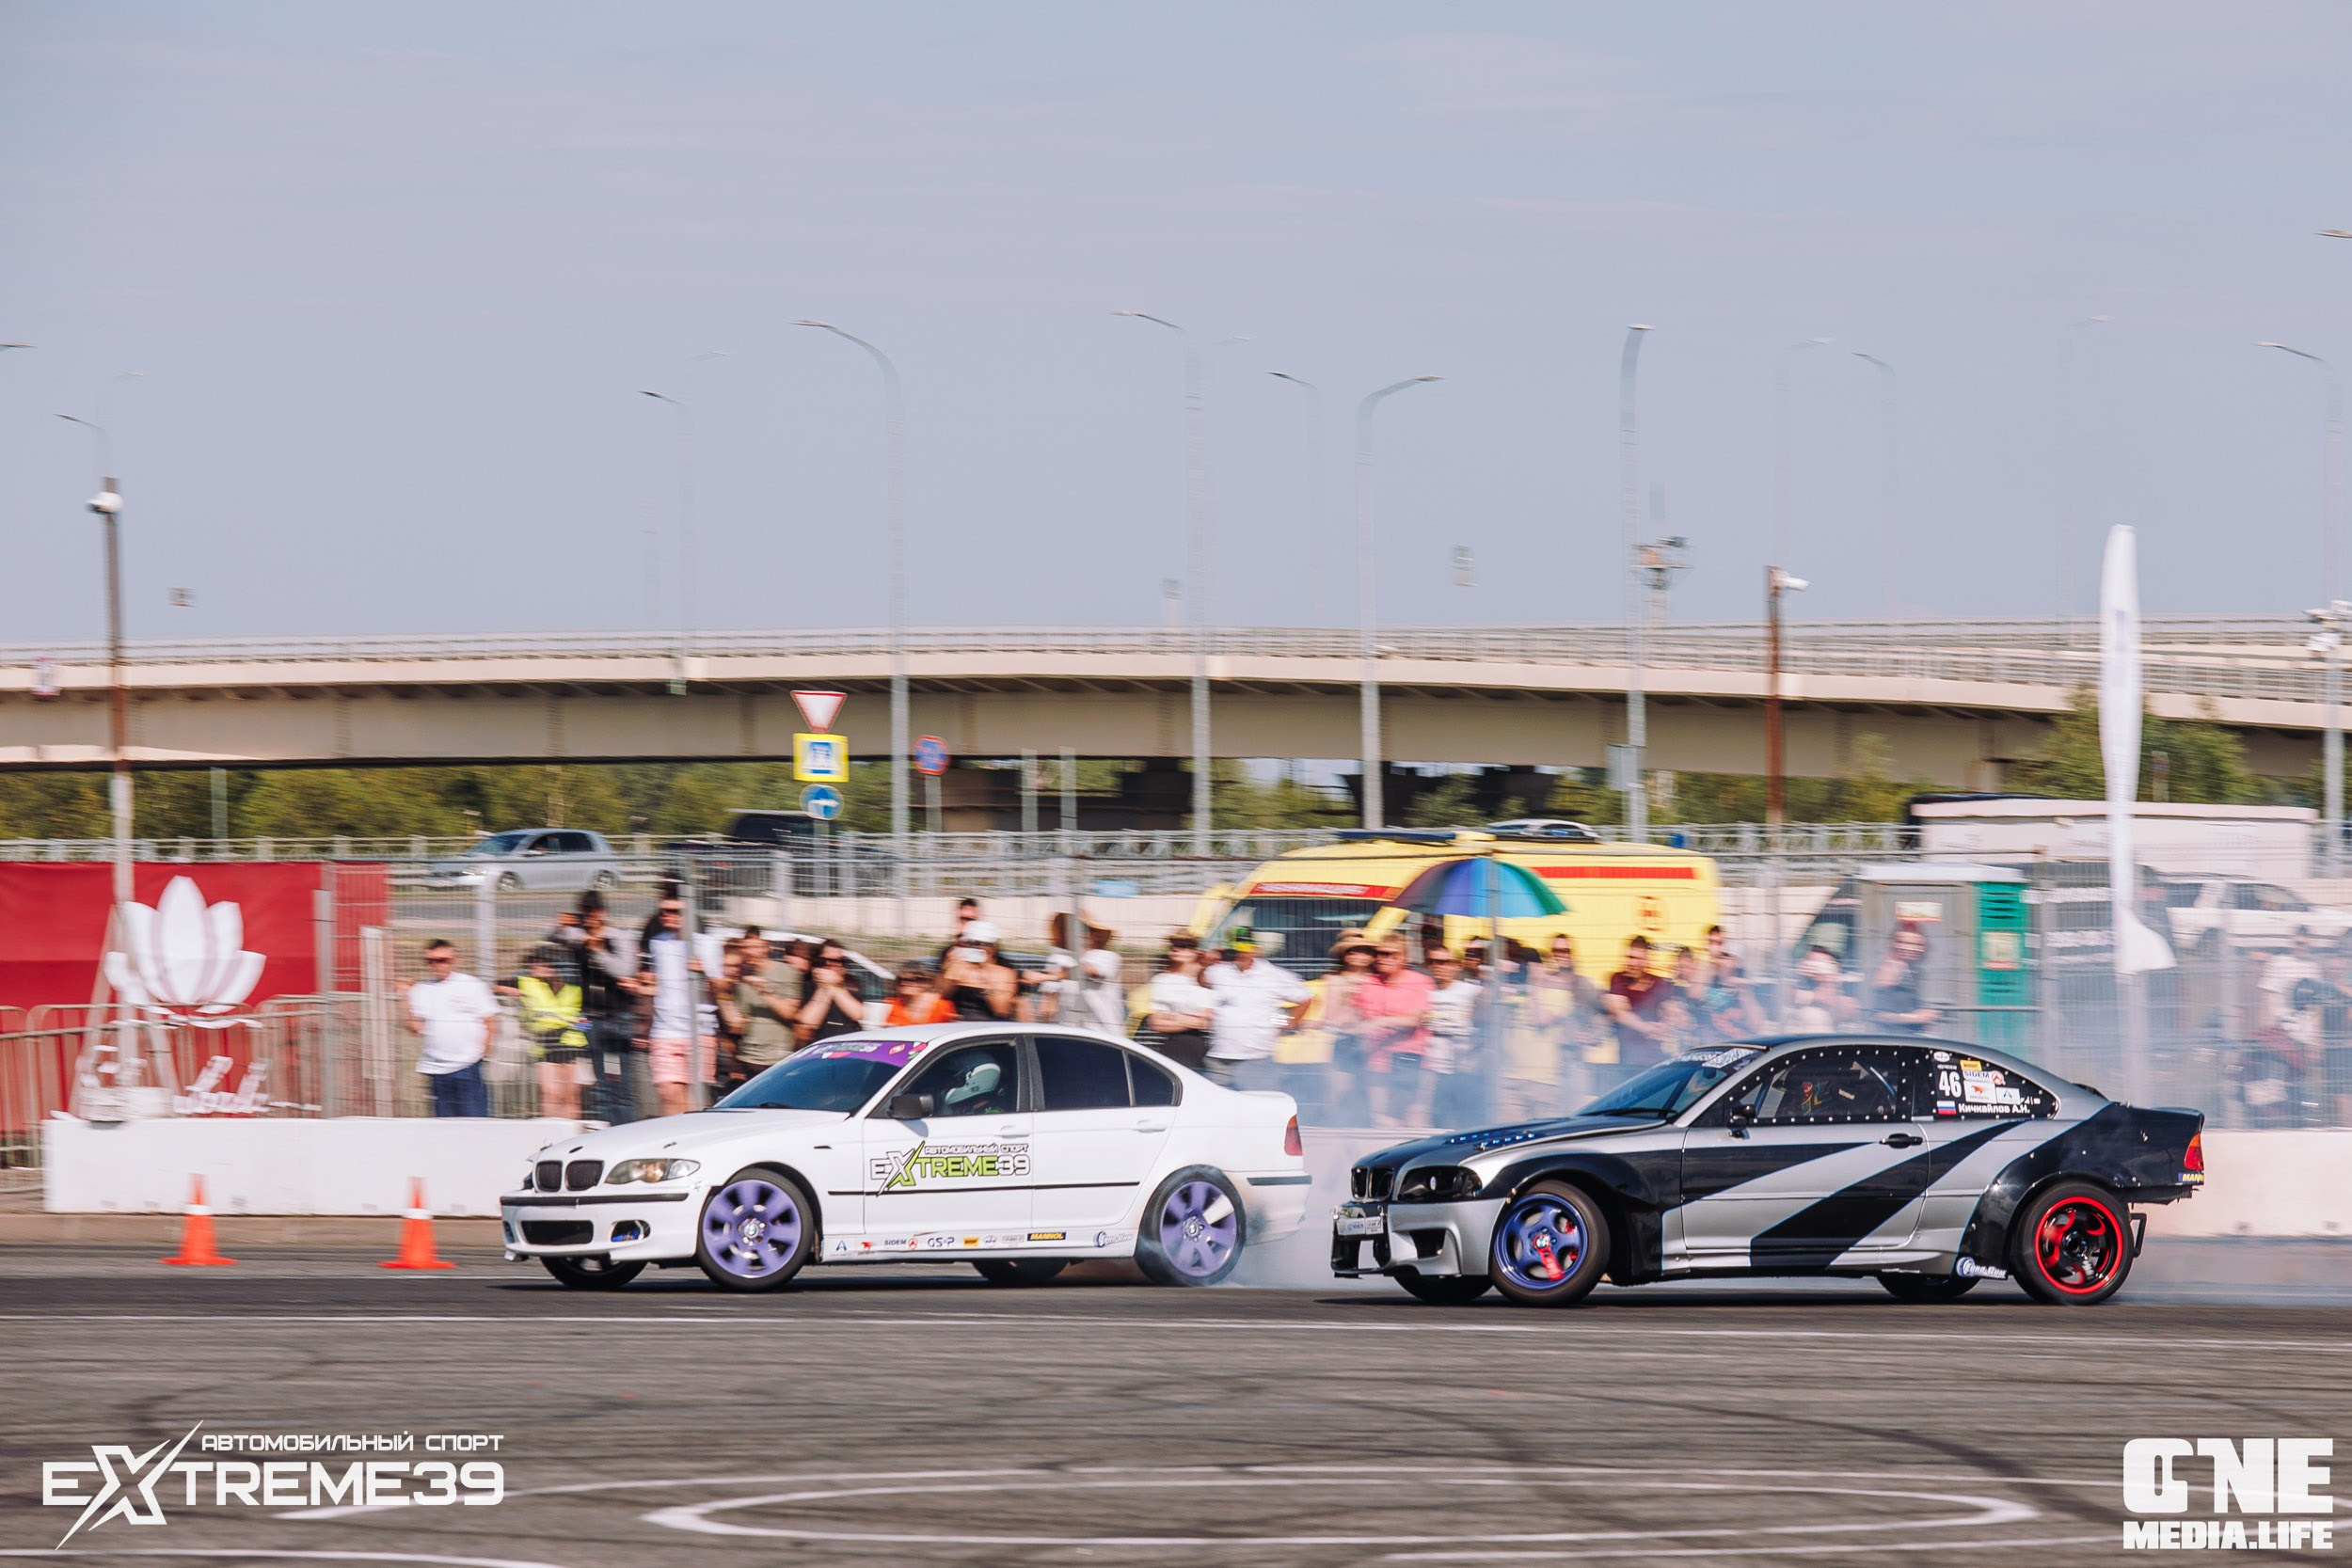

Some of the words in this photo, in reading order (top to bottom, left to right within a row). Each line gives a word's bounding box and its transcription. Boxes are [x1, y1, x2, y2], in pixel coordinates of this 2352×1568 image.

[1938, 1070, 1963, 1099] 46
[924, 1143, 999, 1155] АВТОМОБИЛЬНЫЙ
[1000, 1143, 1029, 1153] СПОРТ
[870, 1140, 1031, 1197] EXTREME39
[1029, 1231, 1064, 1241] MANNOL
